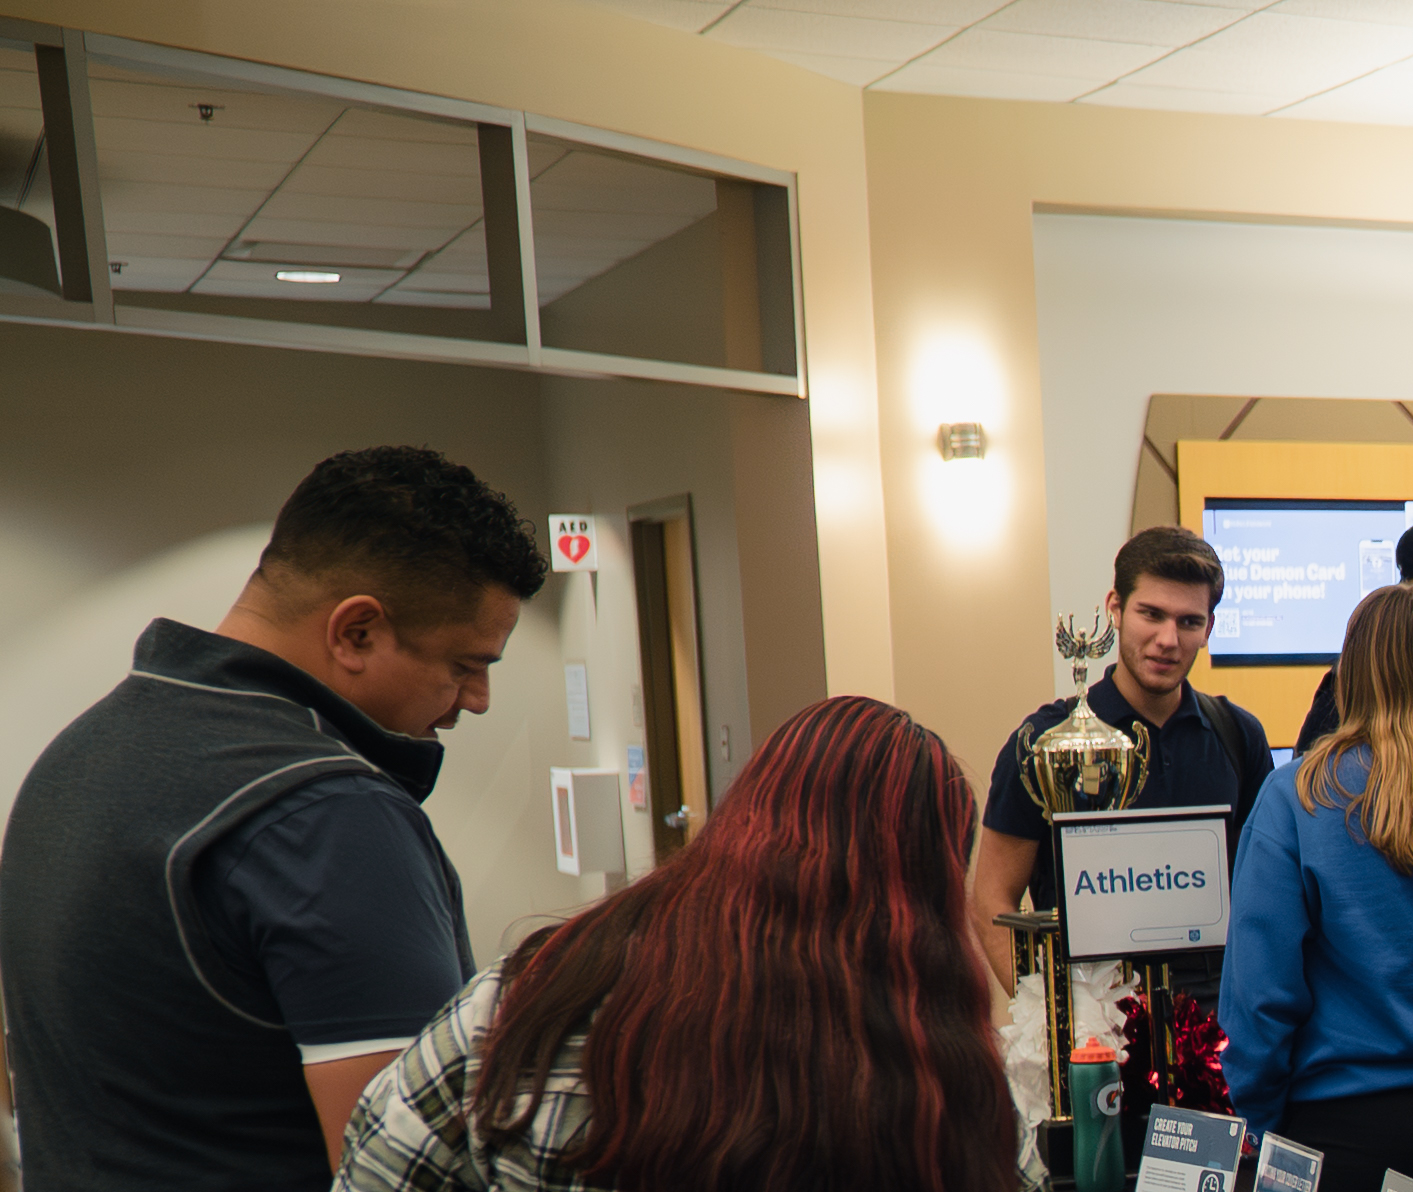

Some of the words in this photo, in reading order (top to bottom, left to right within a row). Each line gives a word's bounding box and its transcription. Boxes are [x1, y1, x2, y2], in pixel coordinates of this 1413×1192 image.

[559, 521, 588, 533] AED
[1243, 548, 1279, 566] your
[1223, 563, 1247, 581] lue
[1250, 563, 1304, 581] Demon
[1307, 562, 1346, 581] Card
[1234, 586, 1271, 603] your
[1273, 583, 1326, 603] phone!
[1074, 864, 1206, 895] Athletics
[1154, 1117, 1178, 1134] CREATE
[1178, 1121, 1194, 1136] YOUR
[1151, 1132, 1180, 1150] ELEVATOR
[1180, 1137, 1198, 1153] PITCH
